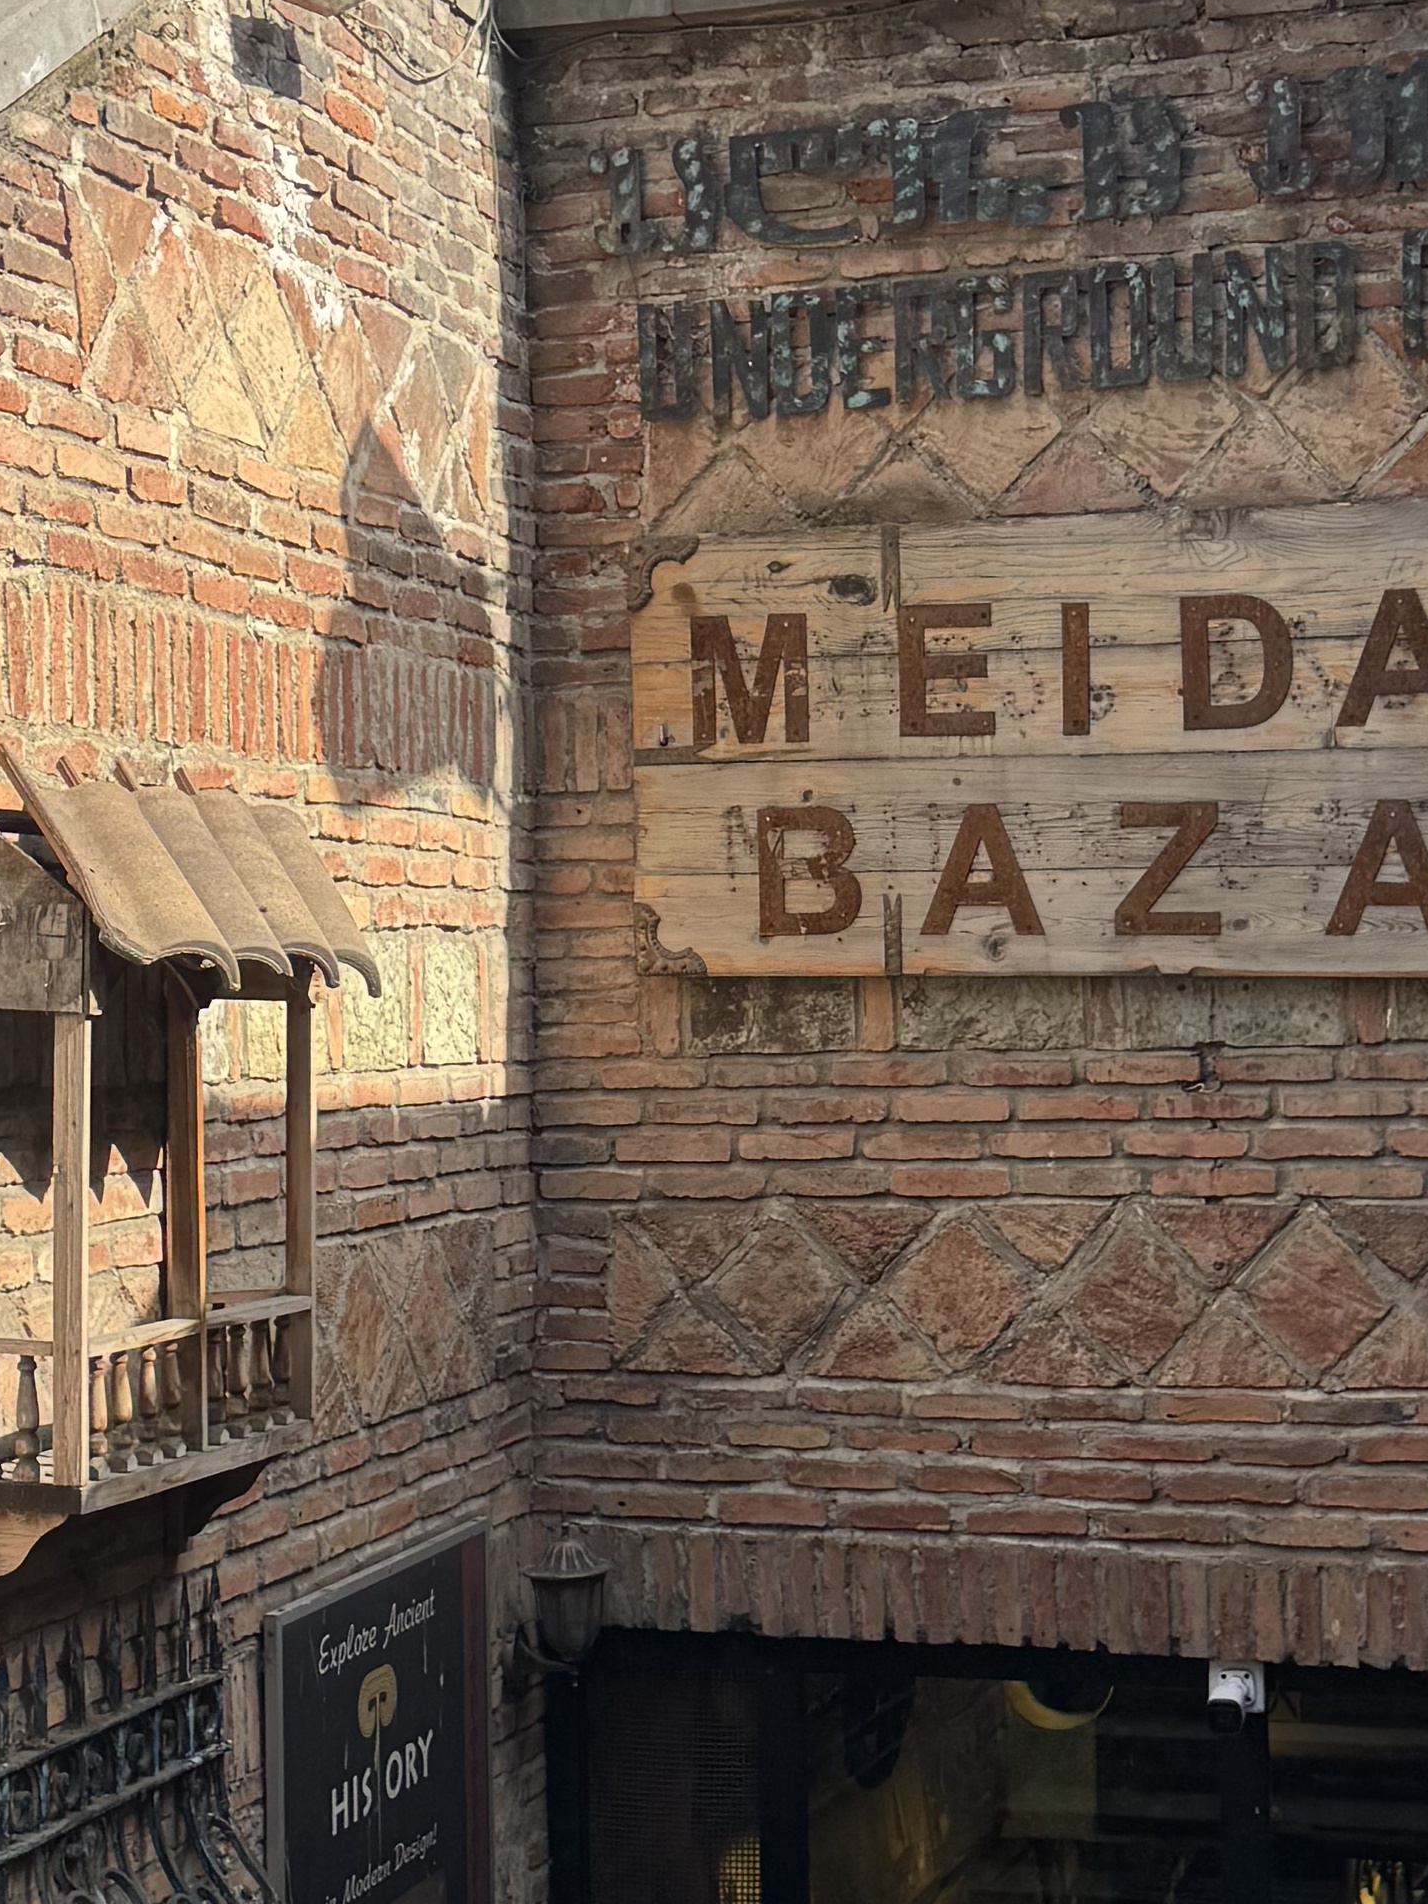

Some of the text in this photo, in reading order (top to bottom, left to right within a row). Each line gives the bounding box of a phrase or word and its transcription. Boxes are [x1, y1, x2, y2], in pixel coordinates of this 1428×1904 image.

[638, 242, 1356, 421] UNDERGROUND
[318, 1588, 436, 1676] Explore Ancient
[394, 1821, 439, 1872] Design!
